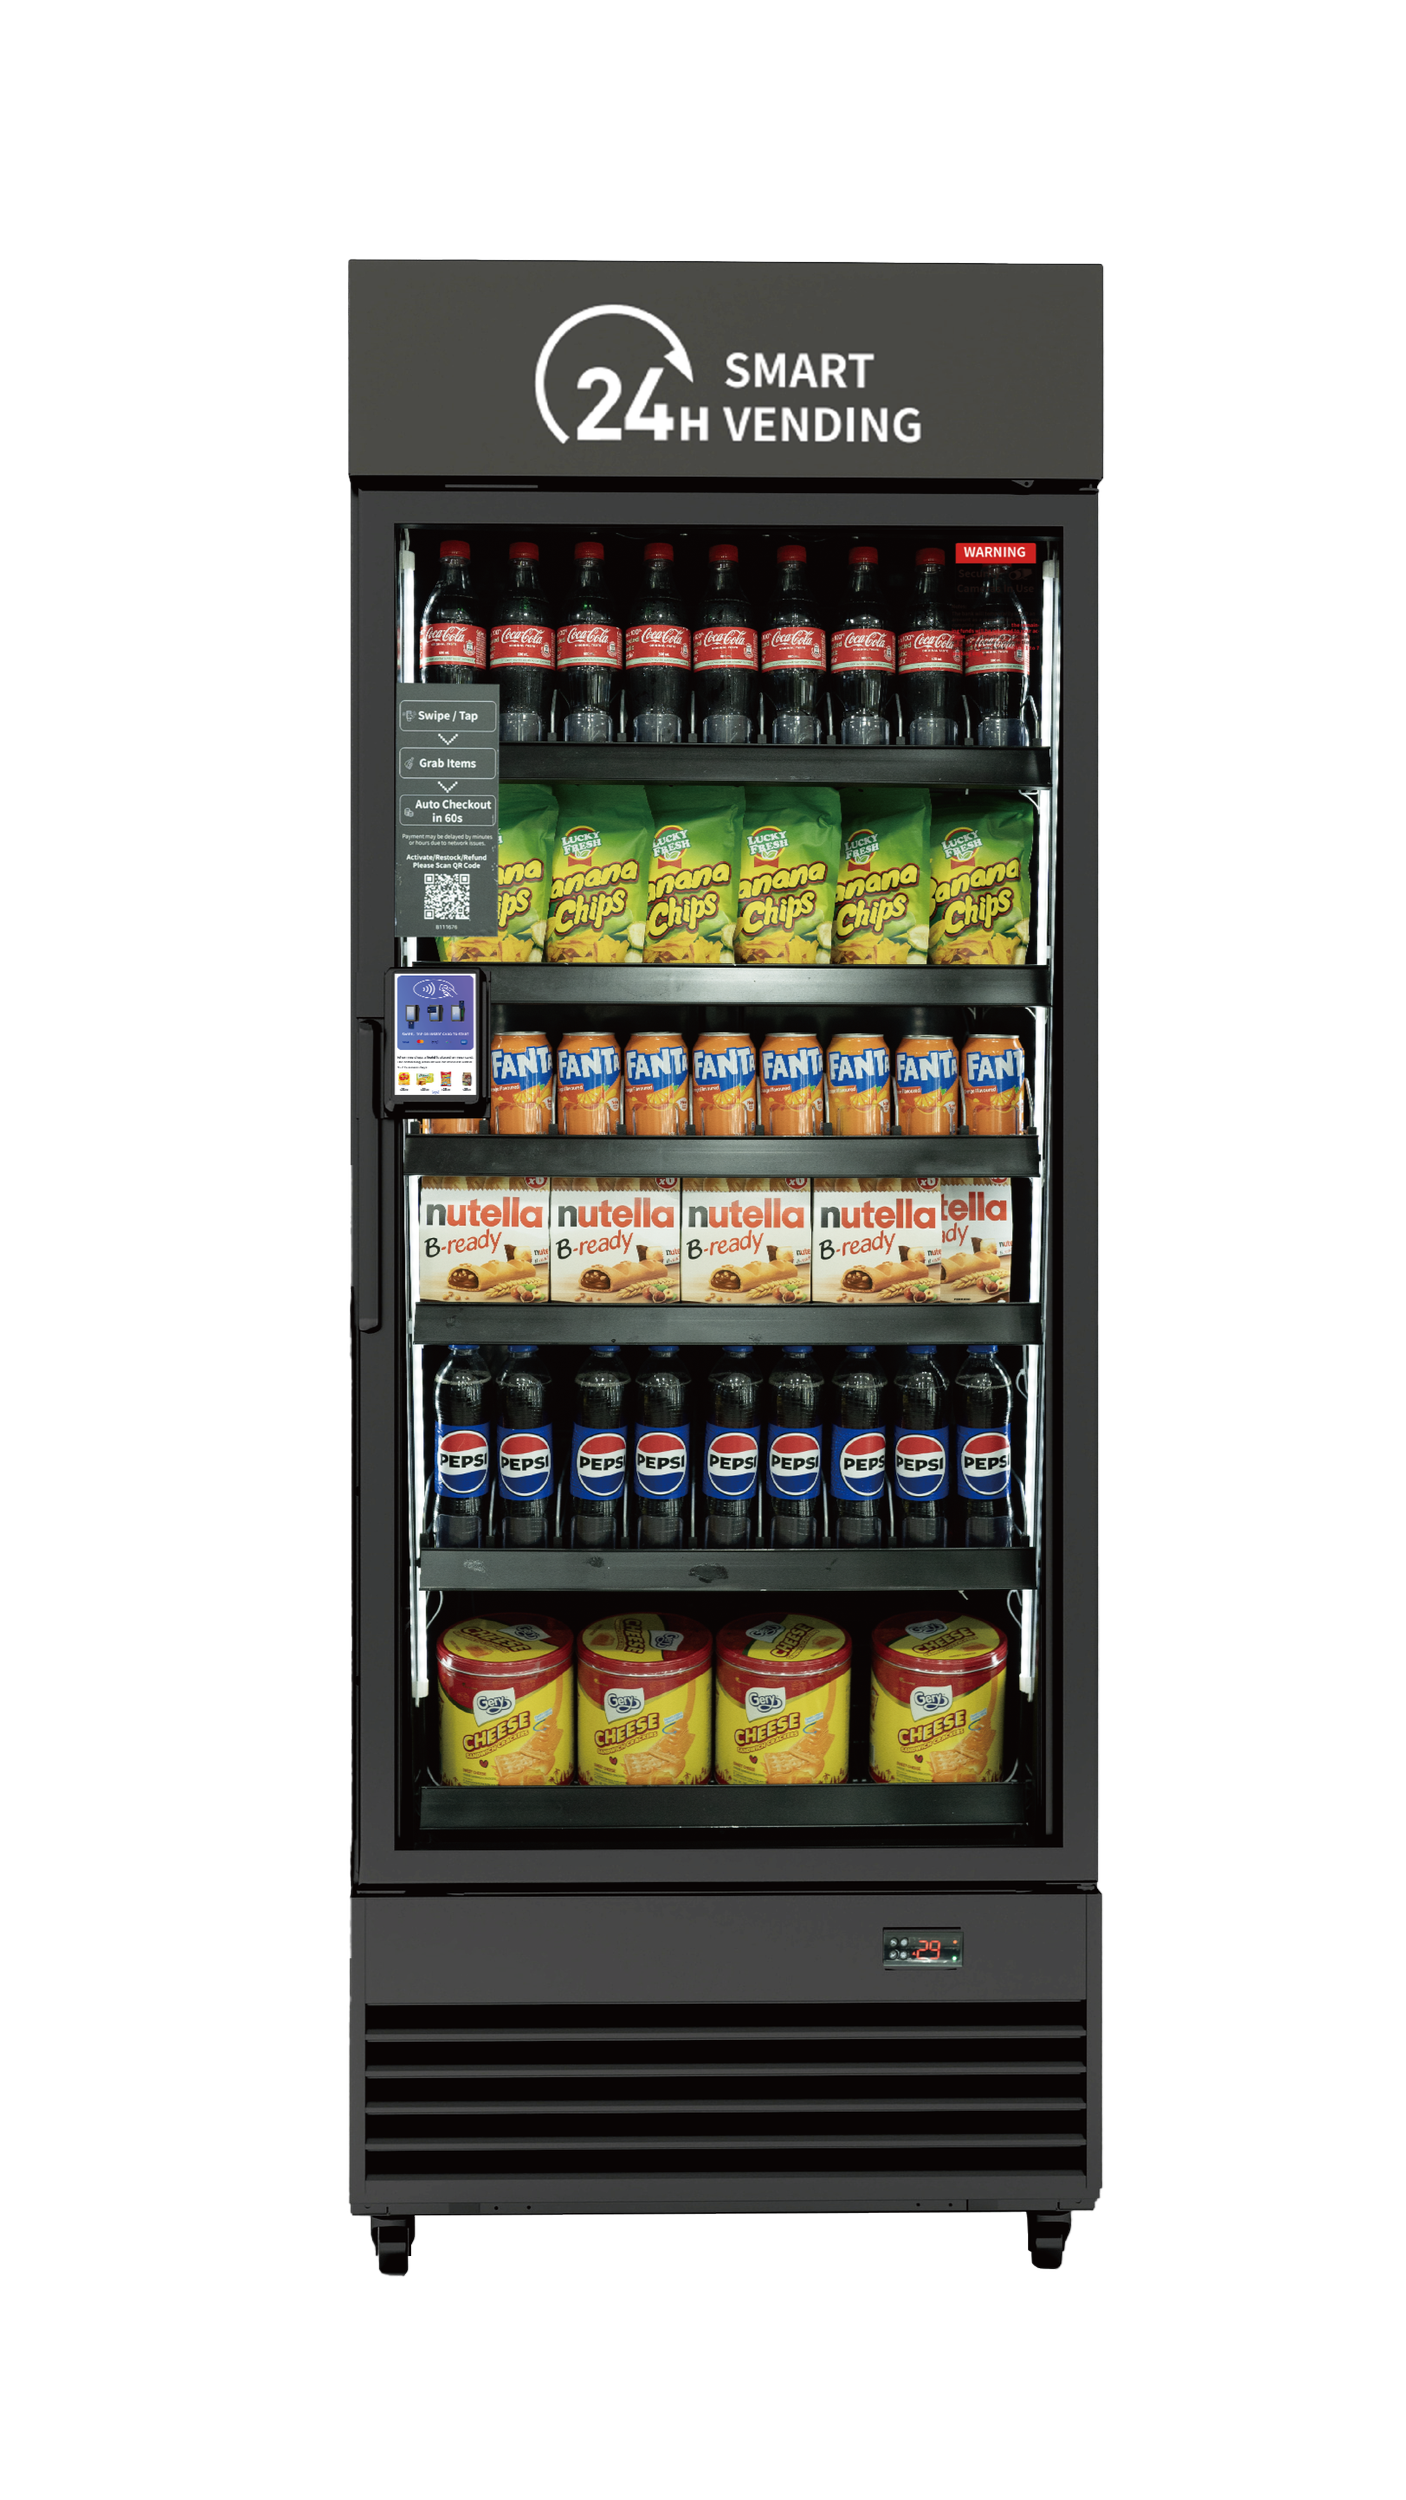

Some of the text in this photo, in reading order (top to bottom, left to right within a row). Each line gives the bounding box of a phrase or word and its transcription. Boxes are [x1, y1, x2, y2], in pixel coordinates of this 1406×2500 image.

[724, 352, 875, 389] SMART
[723, 406, 923, 444] VENDING
[964, 546, 1026, 558] WARNING
[1015, 584, 1035, 593] Use
[425, 627, 468, 643] Coca-Cola
[501, 627, 545, 644] Coca-Cola
[567, 627, 611, 643] Coca-Cola
[641, 627, 684, 644] Coca-Cola
[704, 629, 746, 647] Coca-Cola
[771, 629, 814, 647] Coca-Cola
[844, 632, 888, 648] Coca-Cola
[914, 632, 957, 649] Coca-Cola
[418, 710, 450, 722] Swipe
[459, 711, 478, 722] Tap
[419, 758, 477, 769] Grab Items
[415, 799, 492, 810] Auto Checkout
[432, 812, 463, 823] in 60s
[561, 830, 600, 848] LUCKY
[562, 838, 602, 856] FRESH
[652, 829, 688, 849] LUCKY
[653, 839, 691, 858] FRESH
[746, 830, 787, 846] LUCKY
[749, 838, 788, 855] FRESH
[844, 833, 879, 851] LUCKY
[941, 830, 979, 851] LUCKY
[944, 838, 983, 859] FRESH
[406, 854, 487, 862] Activate/Restock/Refund
[845, 841, 880, 860] FRESH
[452, 862, 463, 870] QR
[551, 859, 639, 900] anana
[648, 860, 731, 905] anana
[737, 860, 828, 902] anana
[834, 862, 920, 904] anana
[554, 886, 628, 936] Chips
[647, 890, 720, 939] Chips
[740, 889, 817, 936] Chips
[835, 892, 909, 938] Chips
[942, 887, 1014, 937] Chips
[426, 1196, 543, 1228] nutella
[558, 1197, 675, 1228] nutella
[688, 1197, 804, 1228] nutella
[820, 1198, 936, 1229] nutella
[941, 1192, 1007, 1221] tella
[424, 1229, 502, 1258] B-ready
[556, 1229, 633, 1259] B-ready
[687, 1229, 764, 1260] B-ready
[819, 1230, 896, 1260] B-ready
[440, 1452, 487, 1469] PEPSI
[501, 1454, 549, 1471] PEPSI
[637, 1454, 685, 1470] PEPSI
[709, 1454, 757, 1470] PEPSI
[771, 1454, 818, 1470] PEPSI
[844, 1455, 885, 1471] PEPS
[896, 1455, 944, 1472] PEPSI
[460, 1626, 532, 1652] CHEESE
[623, 1618, 645, 1654] CHEESE
[770, 1622, 815, 1658] CHEESE
[912, 1627, 976, 1654] CHEESE
[476, 1695, 513, 1716] Gery
[607, 1693, 642, 1714] Gery
[748, 1691, 783, 1713] Gery
[914, 1691, 950, 1712] Gery
[462, 1710, 530, 1752] CHEESE
[594, 1712, 660, 1748] CHEESE
[733, 1712, 801, 1747] CHEESE
[898, 1709, 966, 1746] CHEESE
